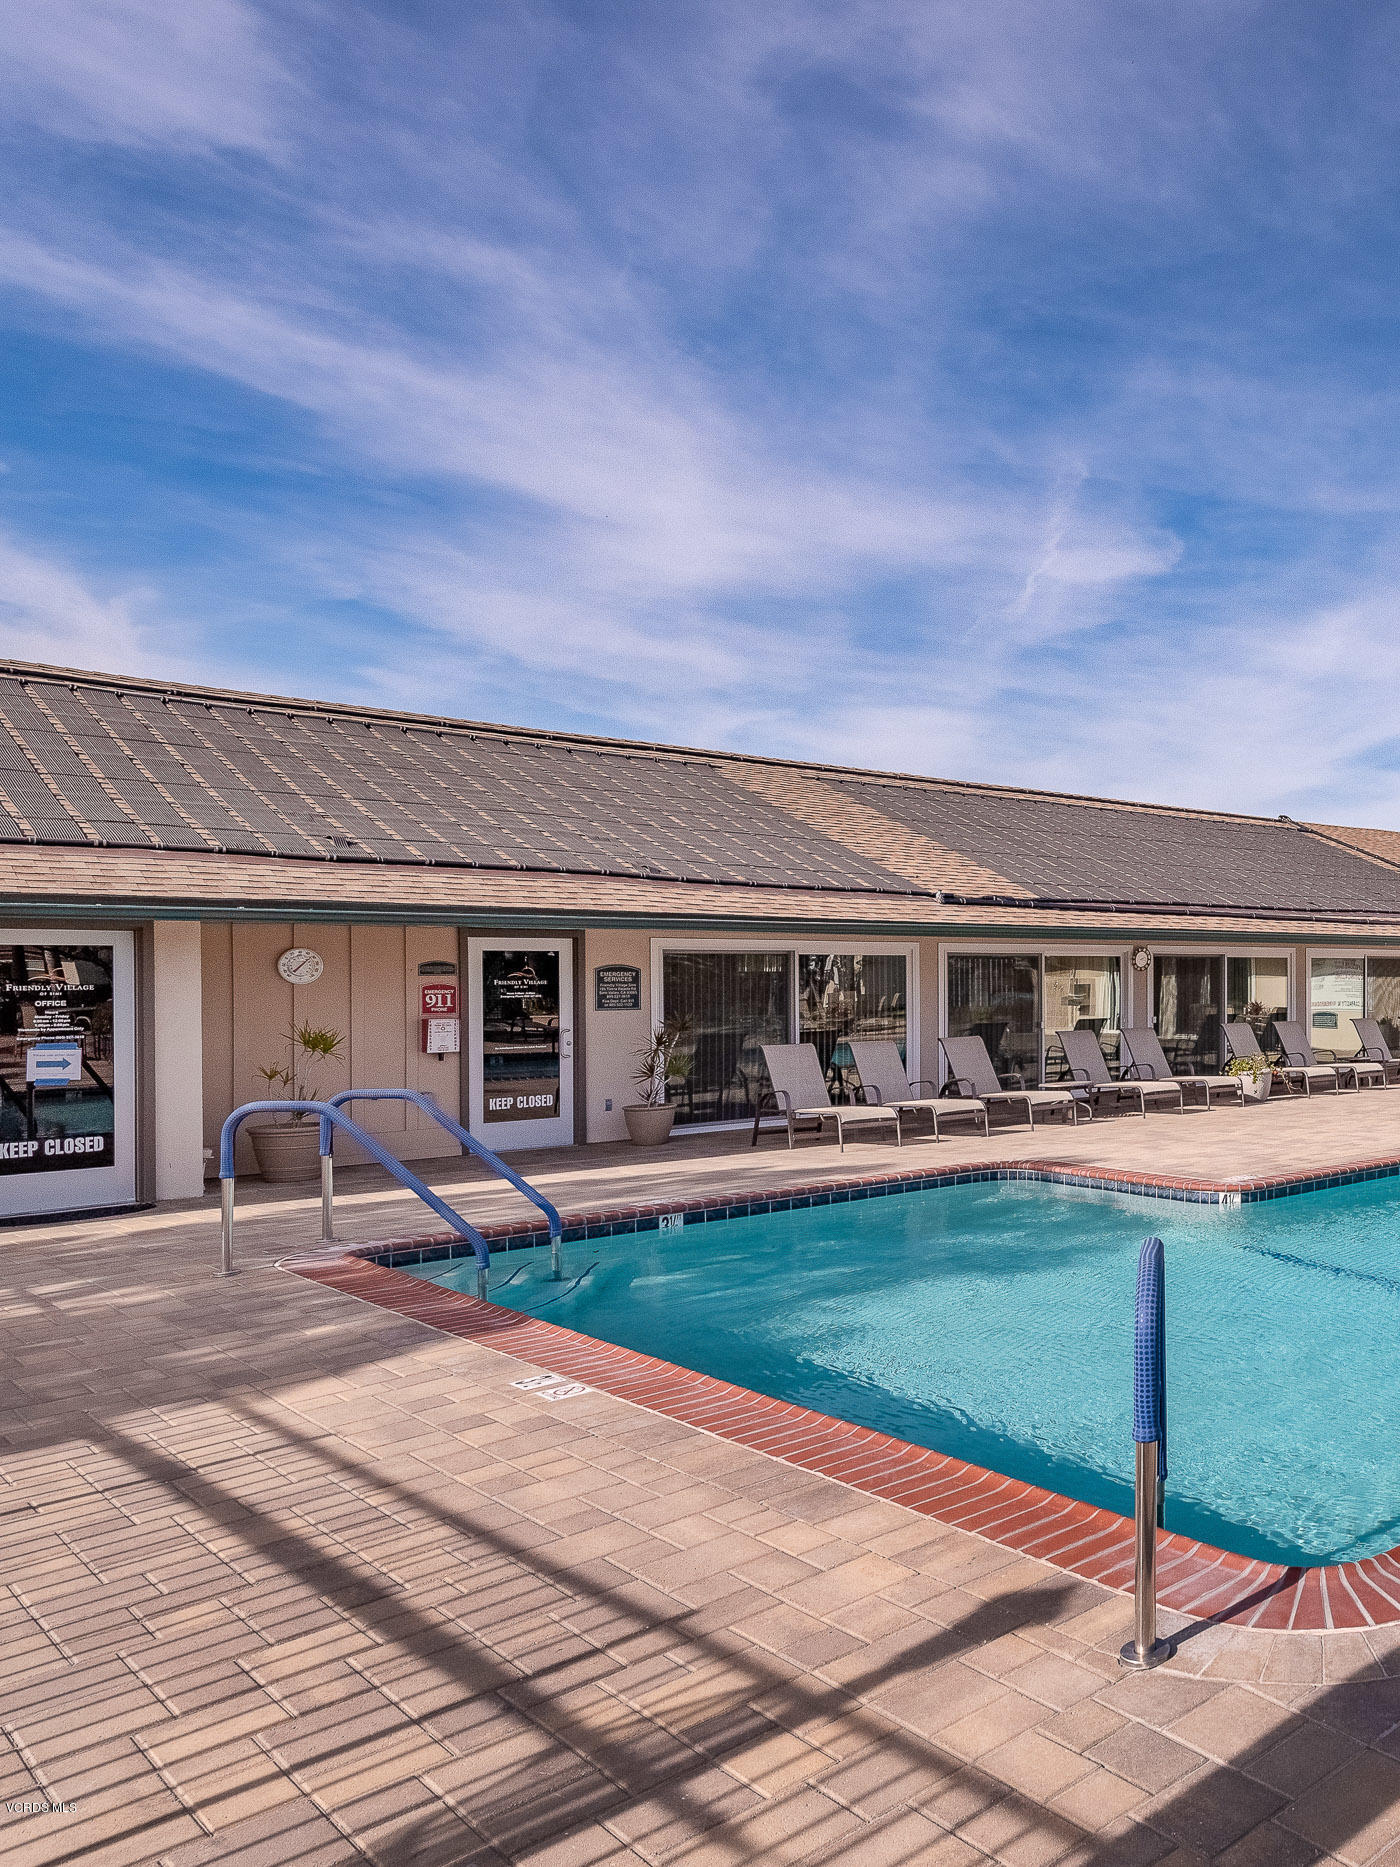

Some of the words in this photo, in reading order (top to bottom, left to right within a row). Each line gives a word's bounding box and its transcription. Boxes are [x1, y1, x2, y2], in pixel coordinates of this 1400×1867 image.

[425, 994, 453, 1008] 911
[489, 1097, 514, 1111] KEEP
[516, 1094, 554, 1109] CLOSED
[0, 1141, 39, 1160] KEEP
[44, 1136, 104, 1156] CLOSED
